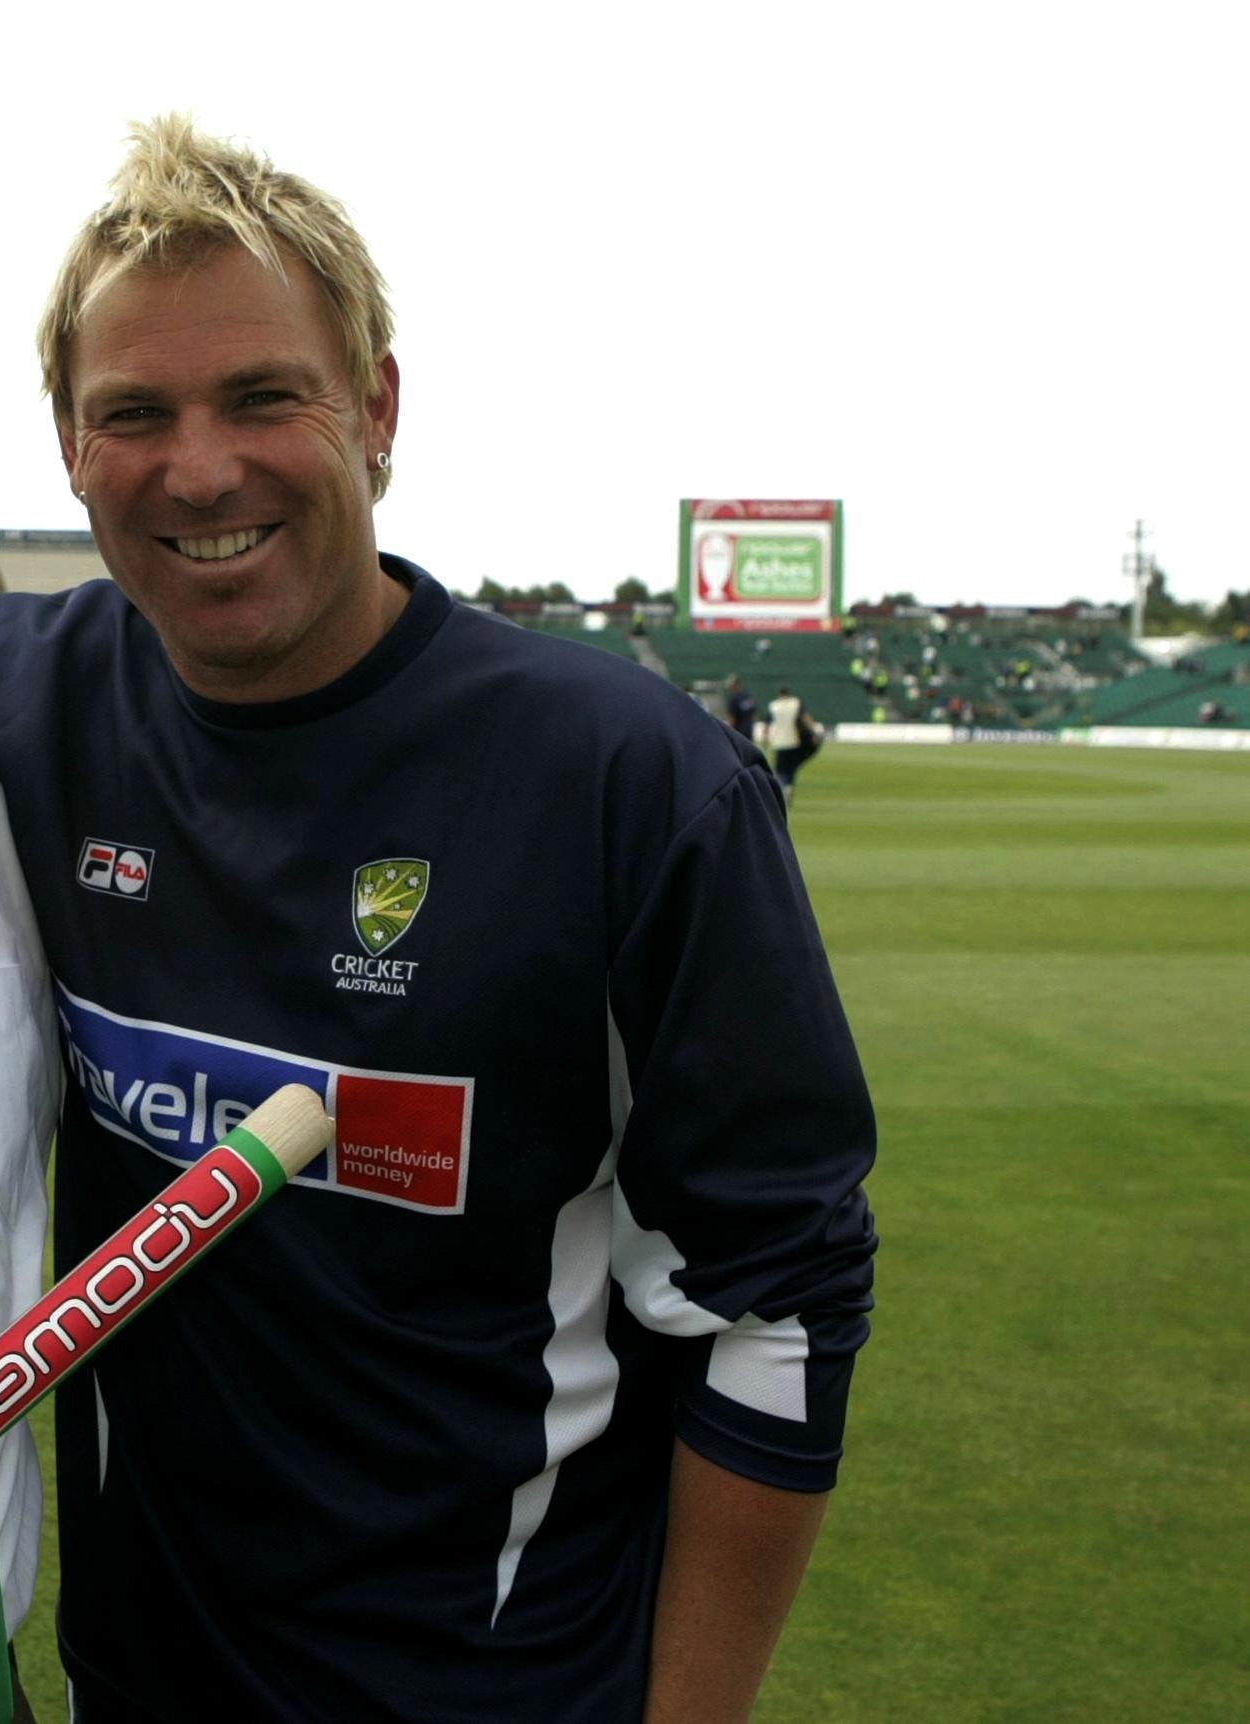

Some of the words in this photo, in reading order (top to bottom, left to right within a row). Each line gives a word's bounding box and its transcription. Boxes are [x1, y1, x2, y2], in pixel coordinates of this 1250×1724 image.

[116, 863, 145, 881] FILA
[331, 954, 419, 981] CRICKET
[336, 977, 406, 996] AUSTRALIA
[342, 1142, 454, 1170] worldwide
[343, 1159, 413, 1188] money
